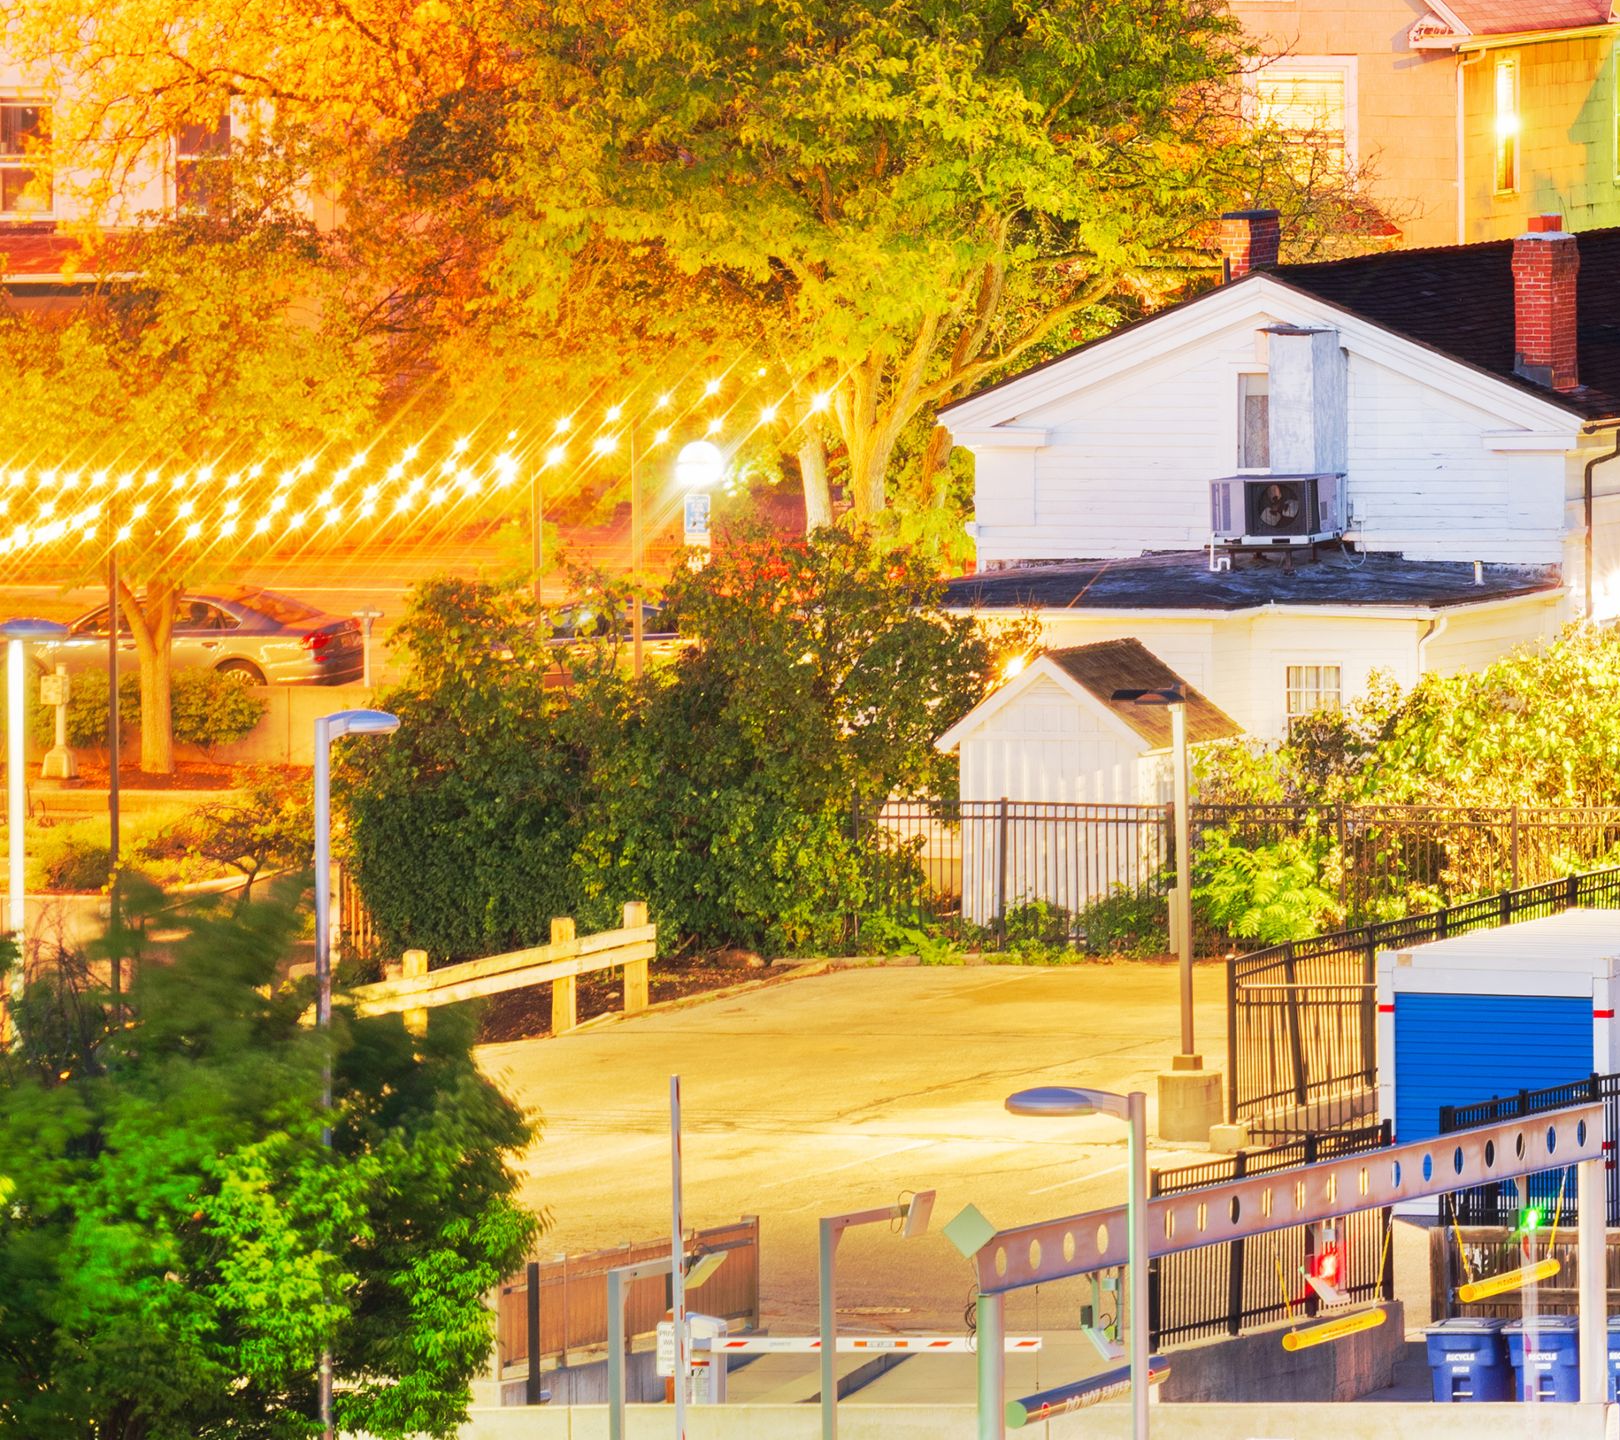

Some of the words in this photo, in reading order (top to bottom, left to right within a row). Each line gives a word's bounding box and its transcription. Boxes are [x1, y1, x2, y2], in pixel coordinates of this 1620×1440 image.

[1446, 1352, 1475, 1361] RECYCLE
[1528, 1352, 1557, 1361] RECYCLE
[1064, 1395, 1081, 1414] DO
[1080, 1387, 1101, 1408] NOT
